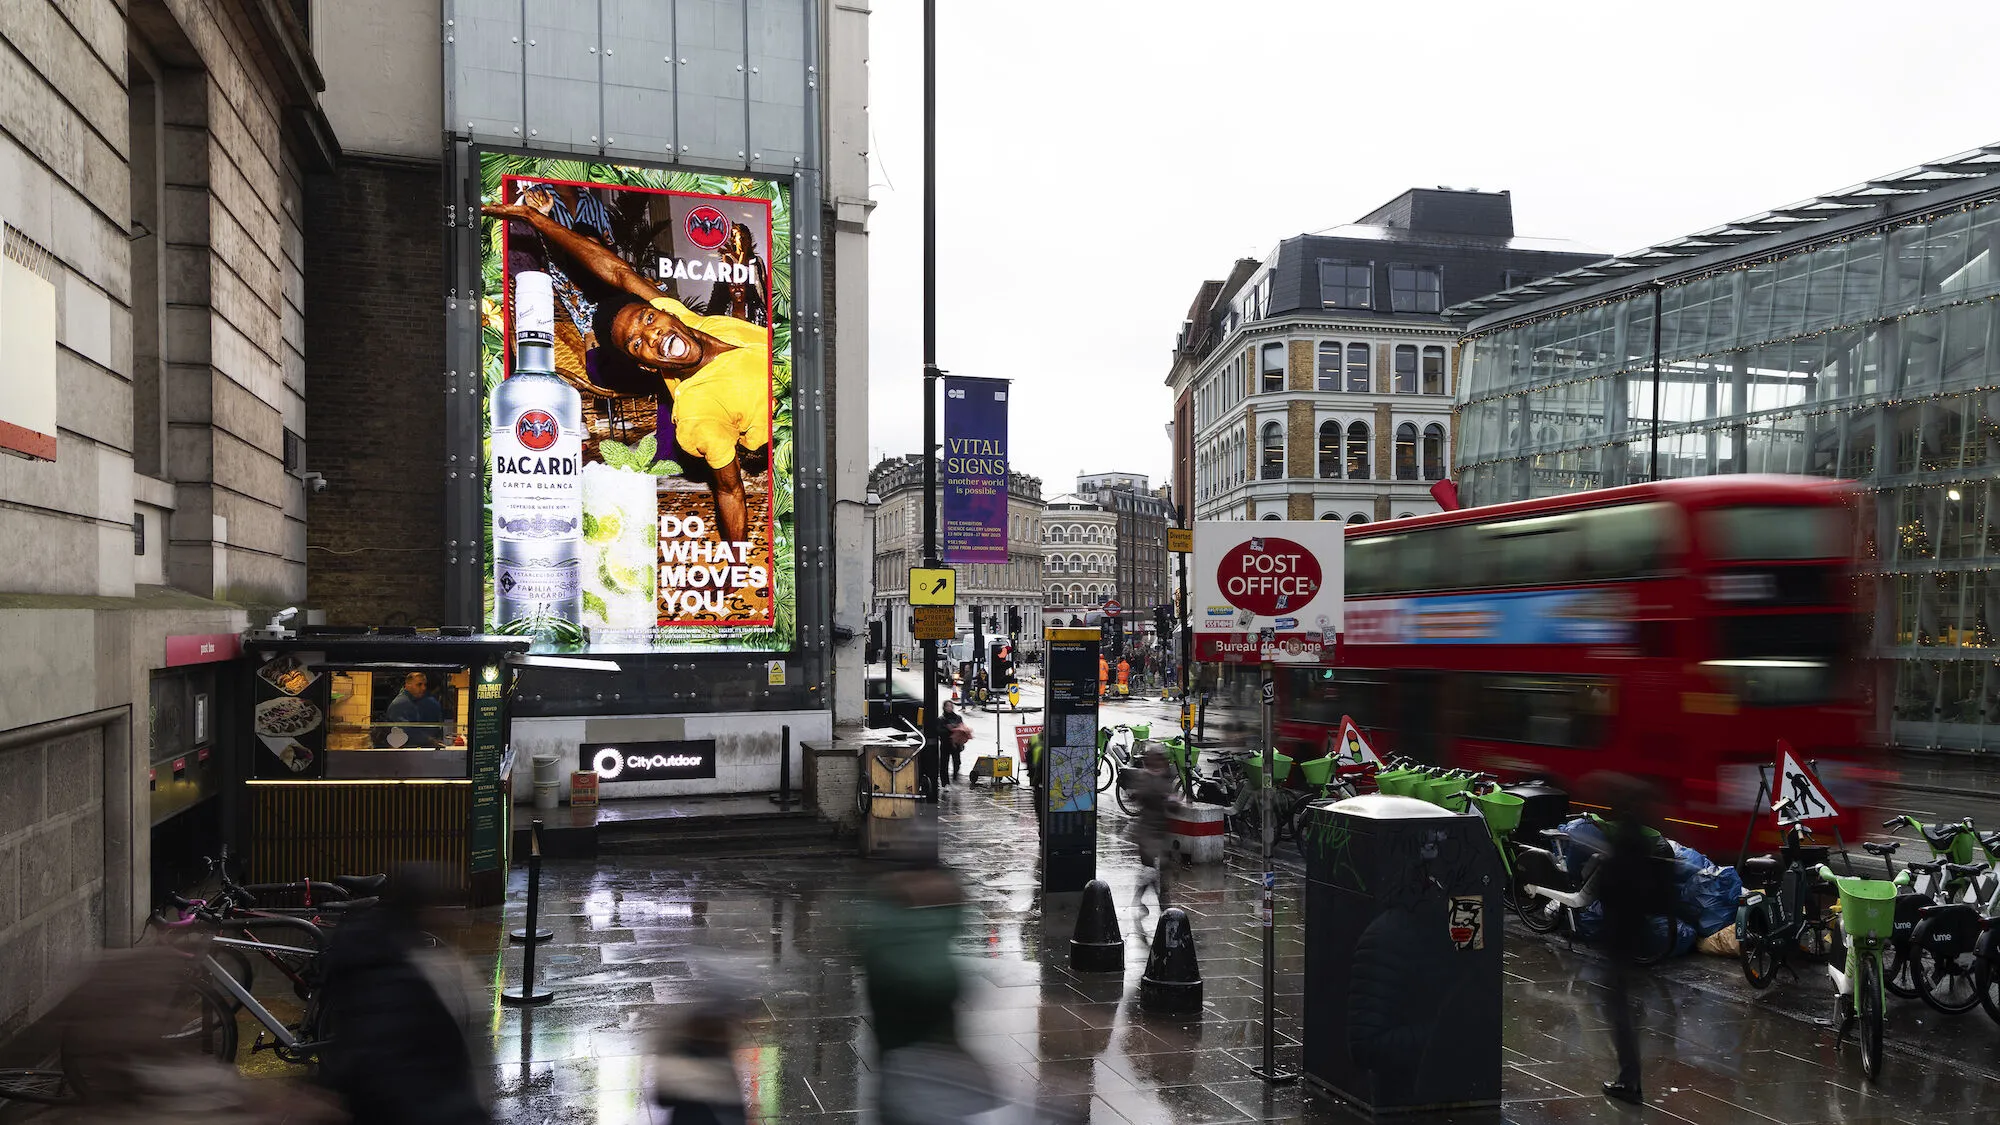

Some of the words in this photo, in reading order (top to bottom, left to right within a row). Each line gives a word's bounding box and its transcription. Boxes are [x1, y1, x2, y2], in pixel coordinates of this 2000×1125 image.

[658, 257, 756, 285] BACARDÍ
[949, 438, 1005, 456] VITAL
[497, 453, 578, 476] BACARDÍ
[947, 458, 1005, 476] SIGNS
[502, 481, 532, 489] CARTA
[948, 478, 980, 486] another
[981, 479, 1005, 487] world
[964, 487, 997, 496] possible
[661, 516, 705, 538] DO
[1169, 532, 1191, 540] Diverted
[661, 541, 751, 564] WHAT
[1242, 554, 1301, 574] POST
[661, 566, 768, 589] MOVES
[1227, 576, 1309, 596] OFFICE
[1216, 640, 1257, 652] Bureau
[1261, 640, 1275, 651] de
[627, 754, 702, 771] CityOutdoor
